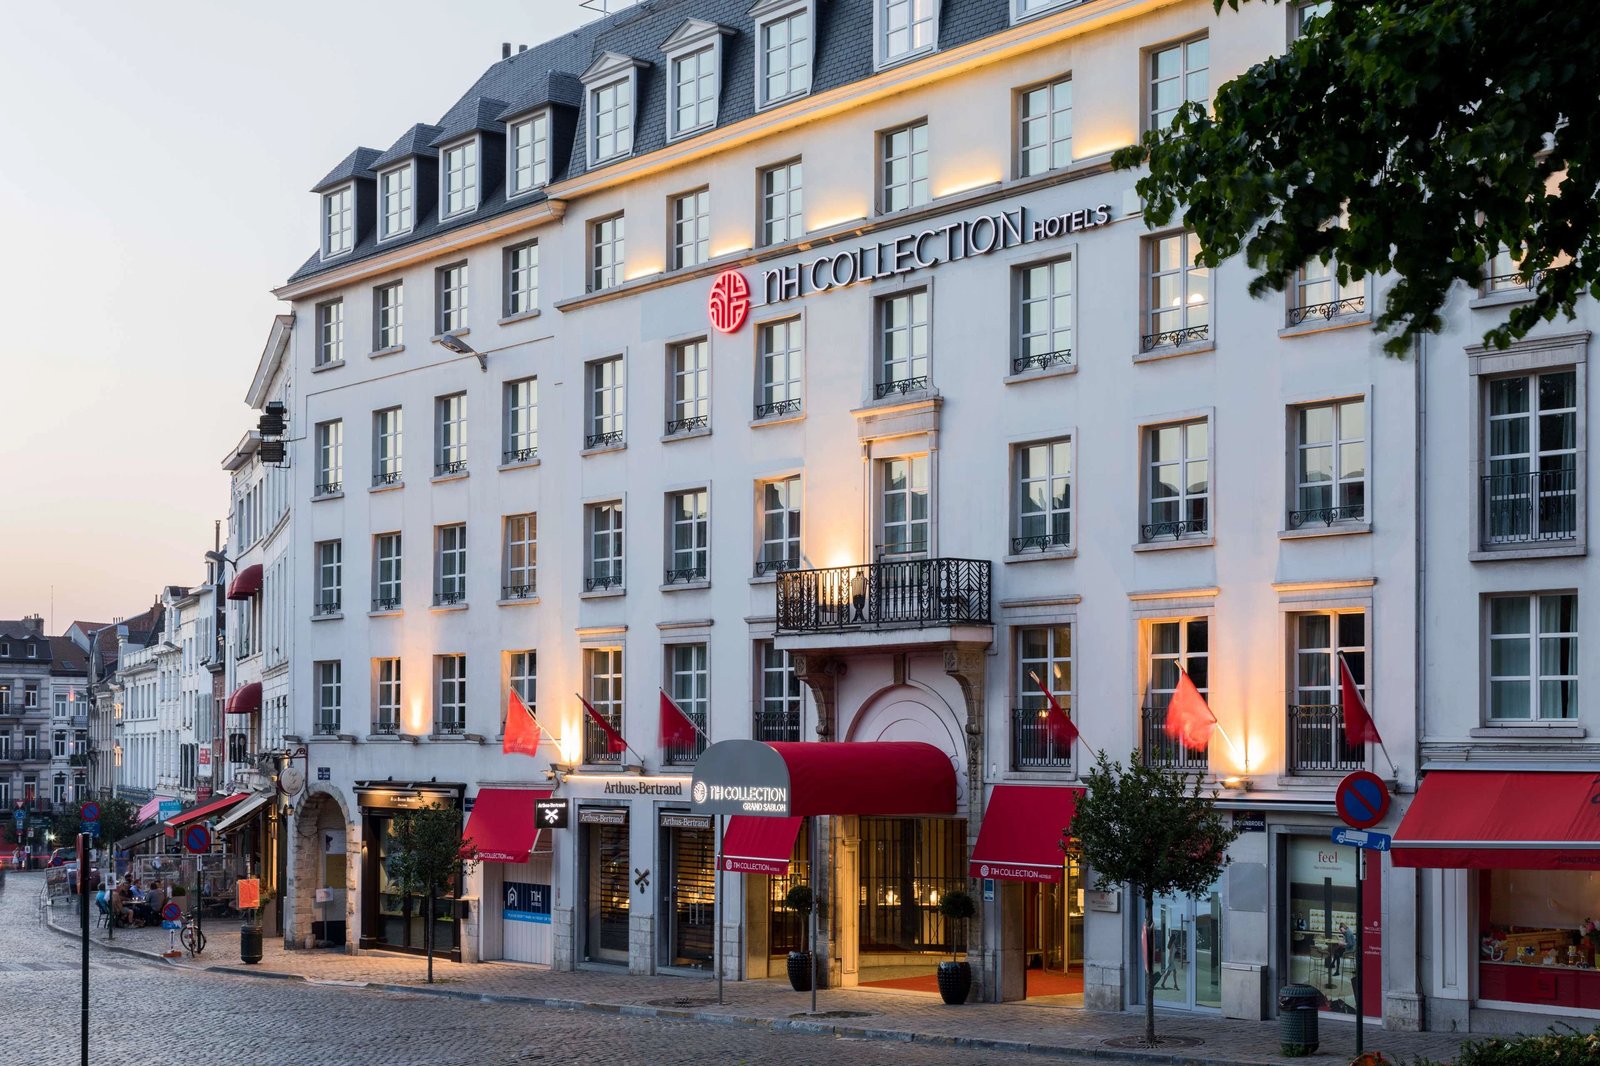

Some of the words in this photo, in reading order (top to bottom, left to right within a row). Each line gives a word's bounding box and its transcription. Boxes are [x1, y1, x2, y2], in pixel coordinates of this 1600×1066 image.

[810, 206, 1026, 292] COLLECTION
[1032, 203, 1112, 241] HOTELS
[604, 781, 683, 796] Arthus-Bertrand
[724, 786, 787, 802] COLLECTION
[742, 802, 762, 812] GRAND
[763, 803, 787, 813] SABLON
[580, 813, 624, 824] Arthus-Bertrand
[662, 816, 709, 827] Arthus-Bertrand
[485, 852, 507, 860] COLLECTION
[1317, 850, 1338, 863] feel
[741, 862, 770, 871] COLLECTION
[1000, 868, 1039, 879] COLLECTION
